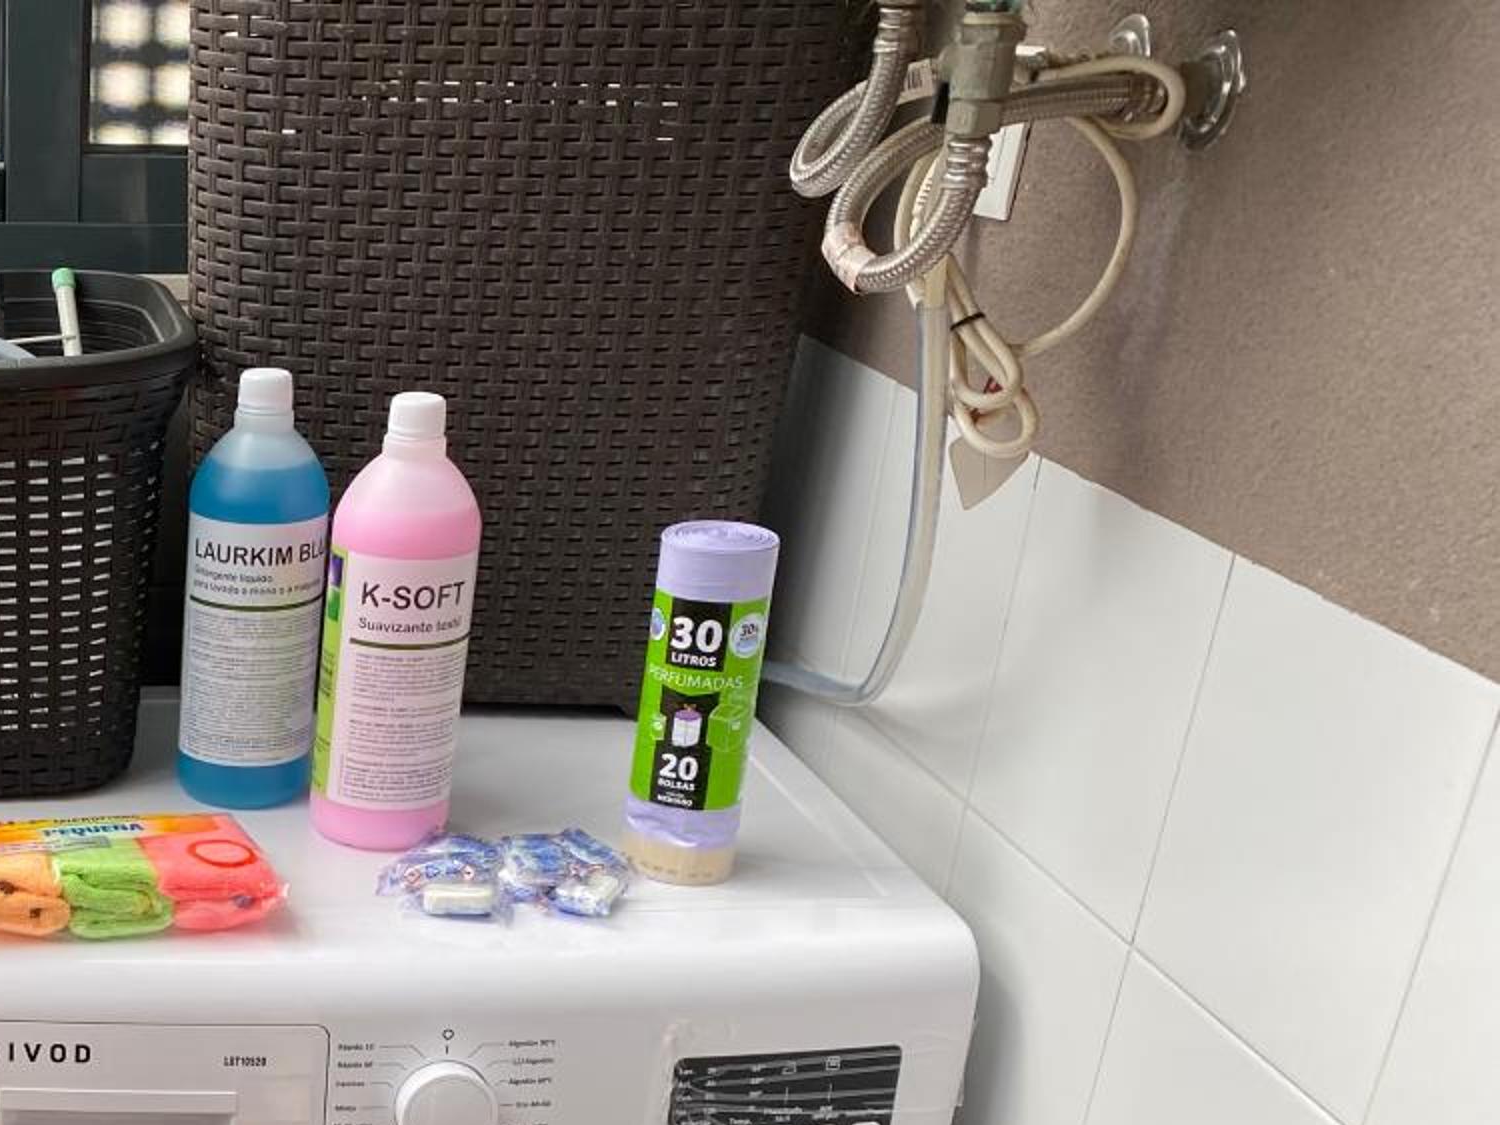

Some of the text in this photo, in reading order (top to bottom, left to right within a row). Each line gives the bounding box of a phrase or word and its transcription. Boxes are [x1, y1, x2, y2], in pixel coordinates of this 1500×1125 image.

[195, 536, 293, 567] LAURKIM
[361, 580, 466, 611] K-SOFT
[357, 616, 434, 634] Suavizante
[669, 615, 723, 653] 30
[670, 651, 718, 668] LITROS
[649, 664, 744, 690] PERFUMADAS
[659, 753, 699, 781] 20
[657, 776, 696, 792] BOLSAS
